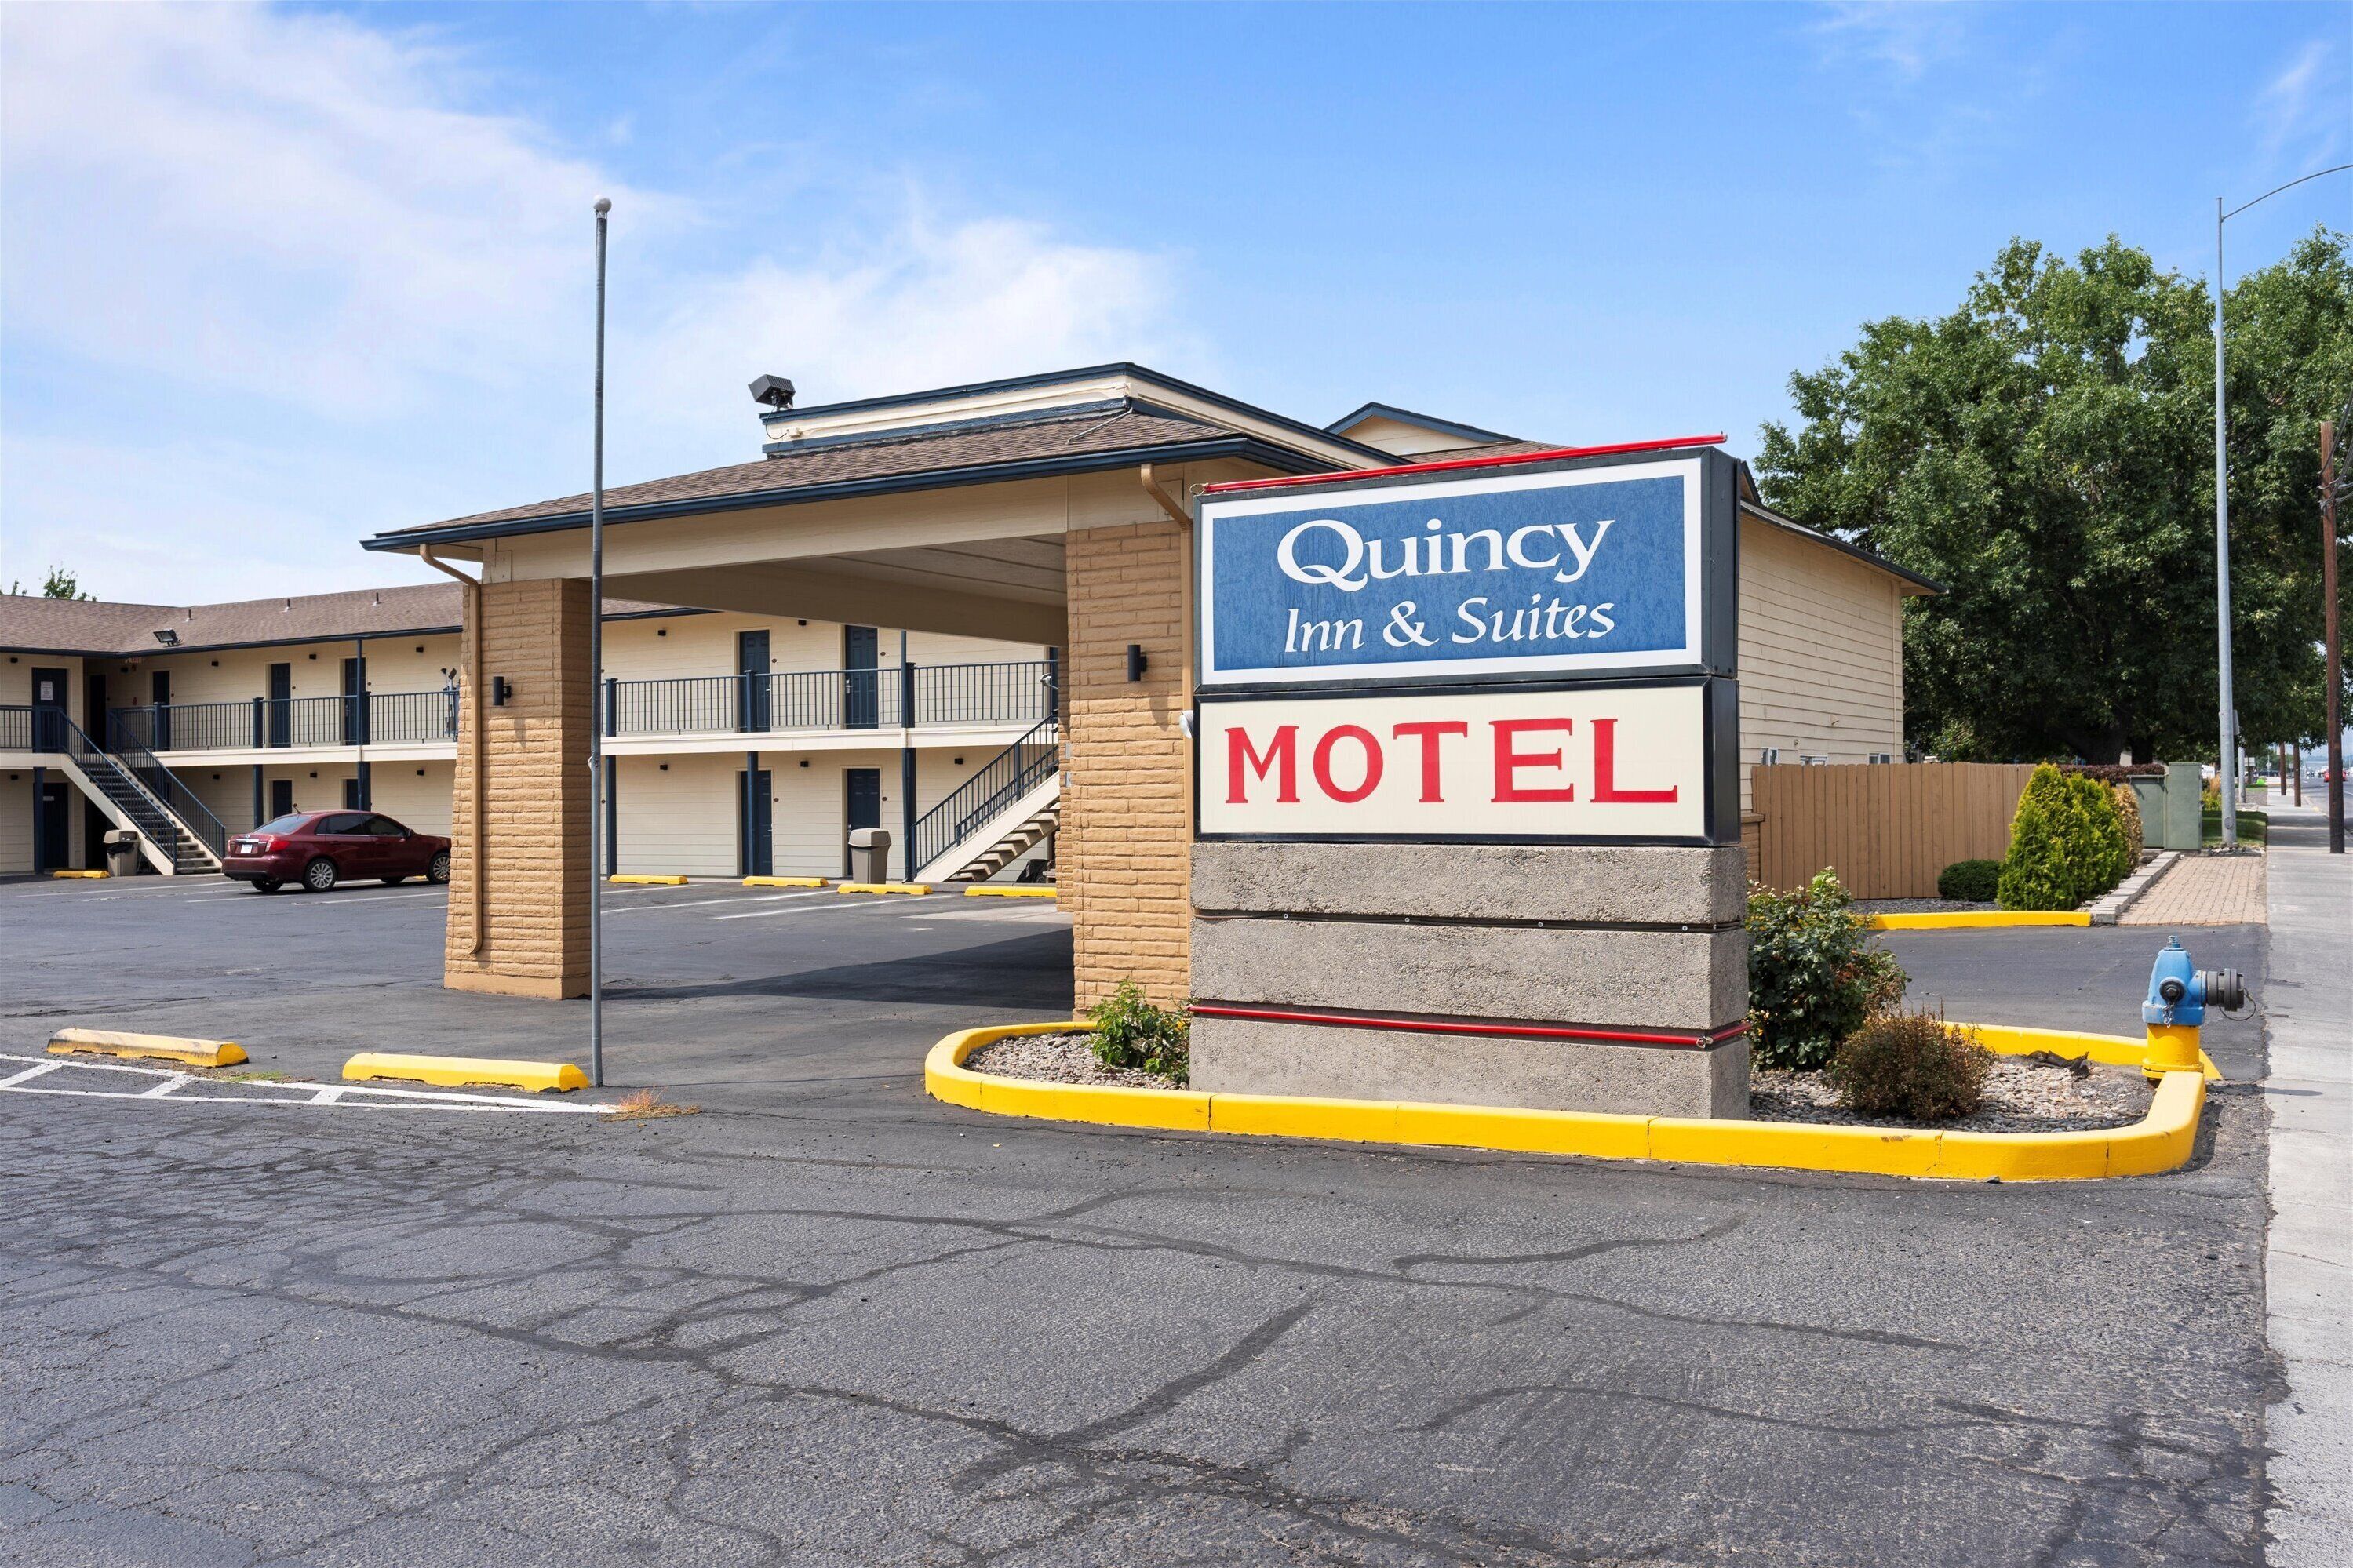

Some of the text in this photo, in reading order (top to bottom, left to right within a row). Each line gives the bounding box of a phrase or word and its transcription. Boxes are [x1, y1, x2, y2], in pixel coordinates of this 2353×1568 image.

[1277, 518, 1615, 591] Quincy
[1284, 593, 1615, 653] Inn & Suites
[1225, 718, 1679, 804] MOTEL
